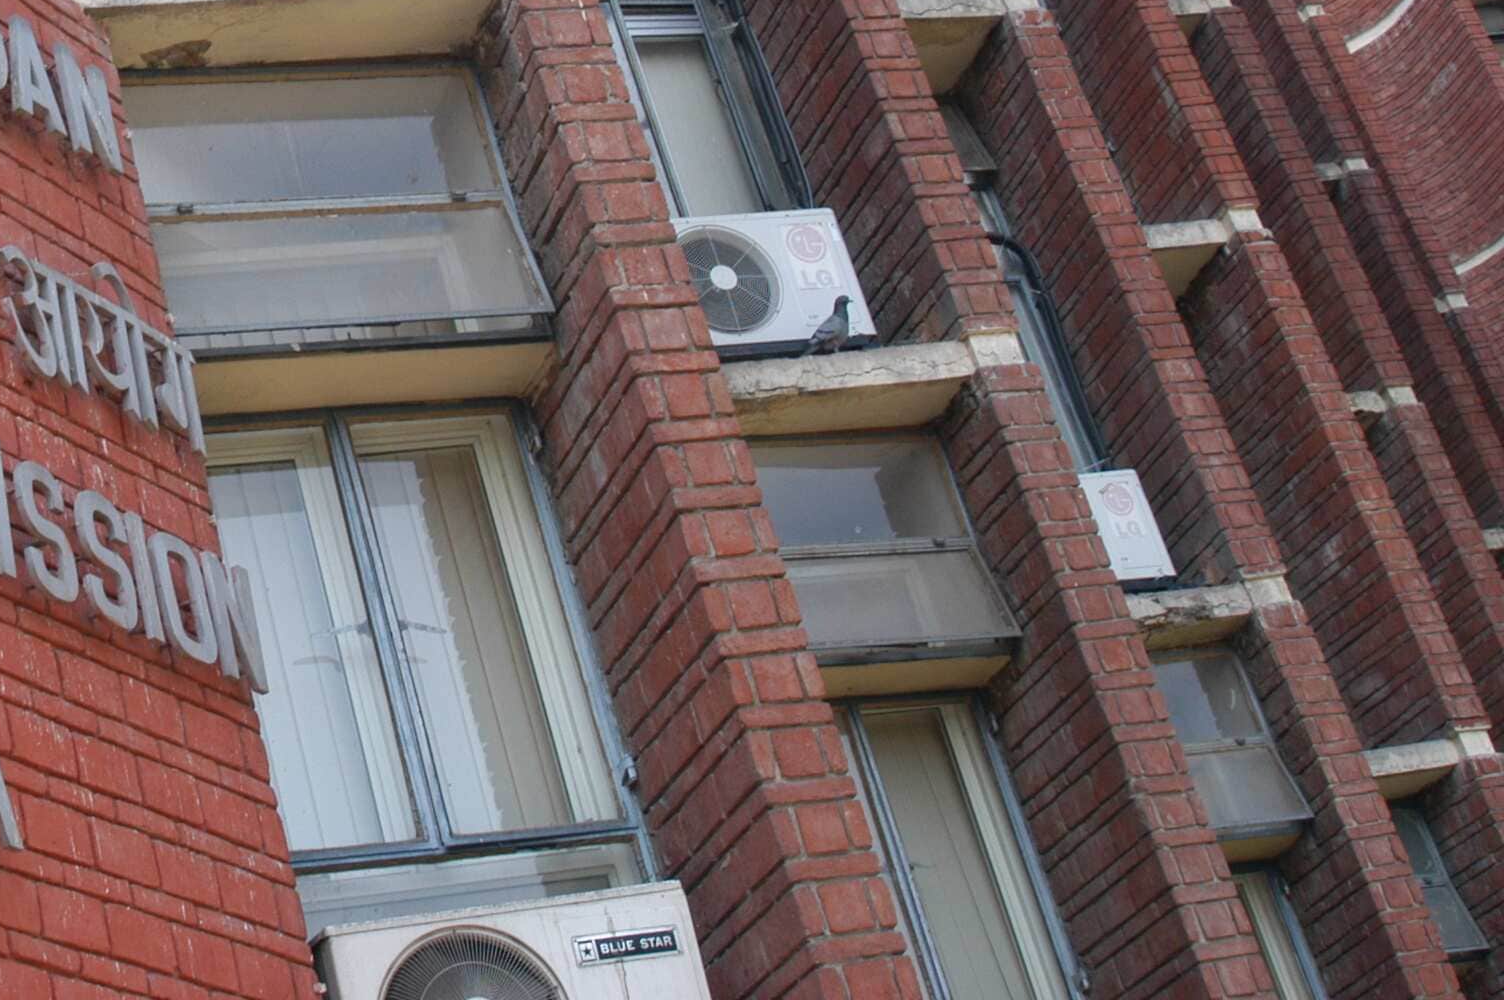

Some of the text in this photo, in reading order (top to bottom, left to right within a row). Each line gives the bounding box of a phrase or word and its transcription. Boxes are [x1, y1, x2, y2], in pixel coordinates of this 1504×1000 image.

[799, 269, 834, 287] LG
[599, 936, 673, 954] BLUE STAR
